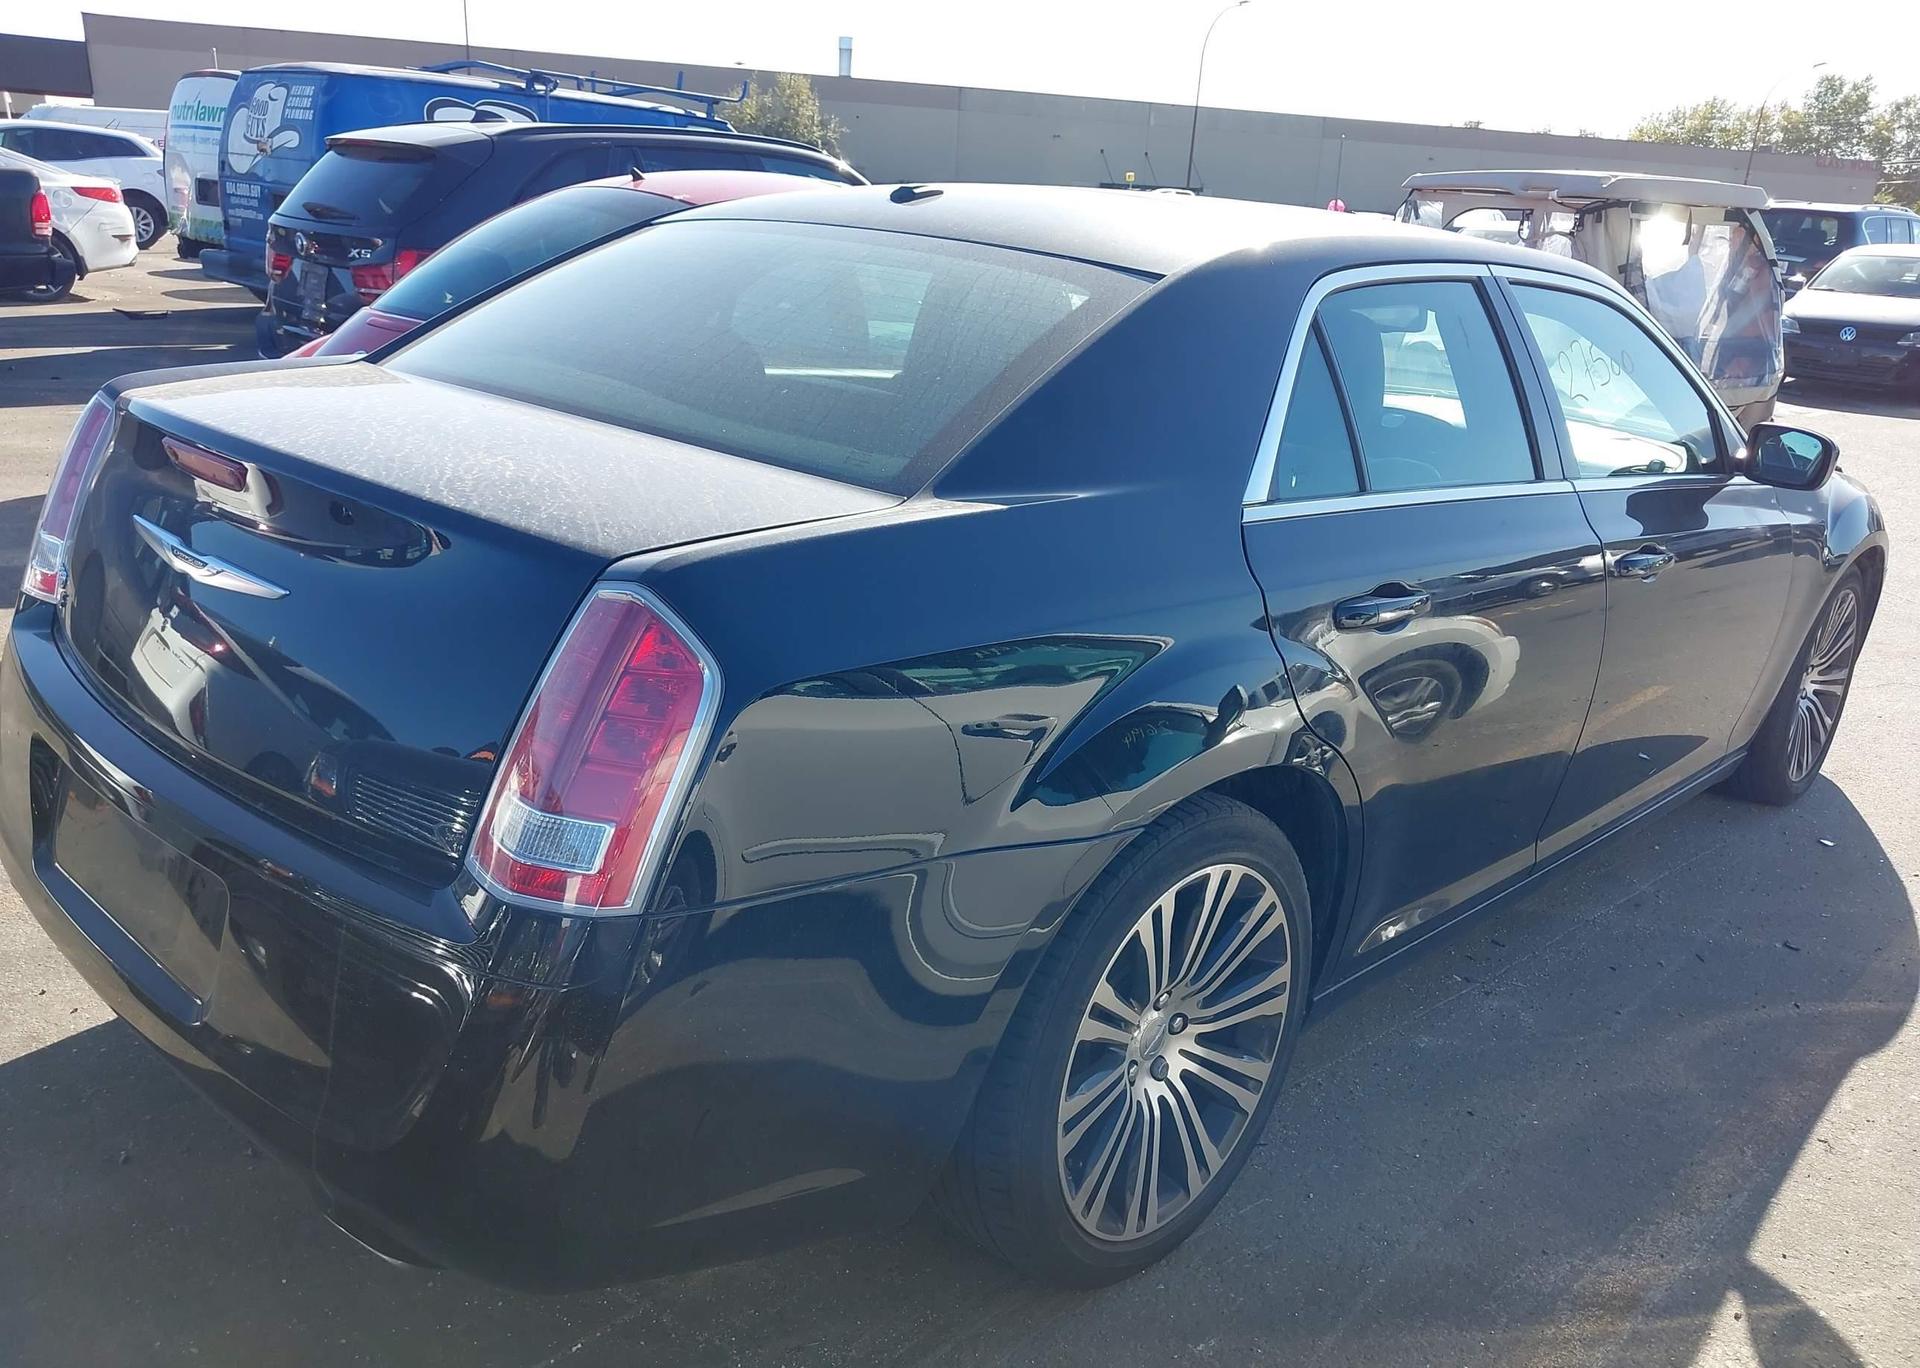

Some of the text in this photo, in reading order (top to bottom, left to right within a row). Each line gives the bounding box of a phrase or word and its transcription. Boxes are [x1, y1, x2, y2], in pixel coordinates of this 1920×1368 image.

[291, 85, 315, 97] HEATING
[287, 96, 313, 108] COOLING
[284, 108, 315, 120] PLUMBING
[347, 248, 372, 259] X5
[1557, 339, 1635, 402] 27500
